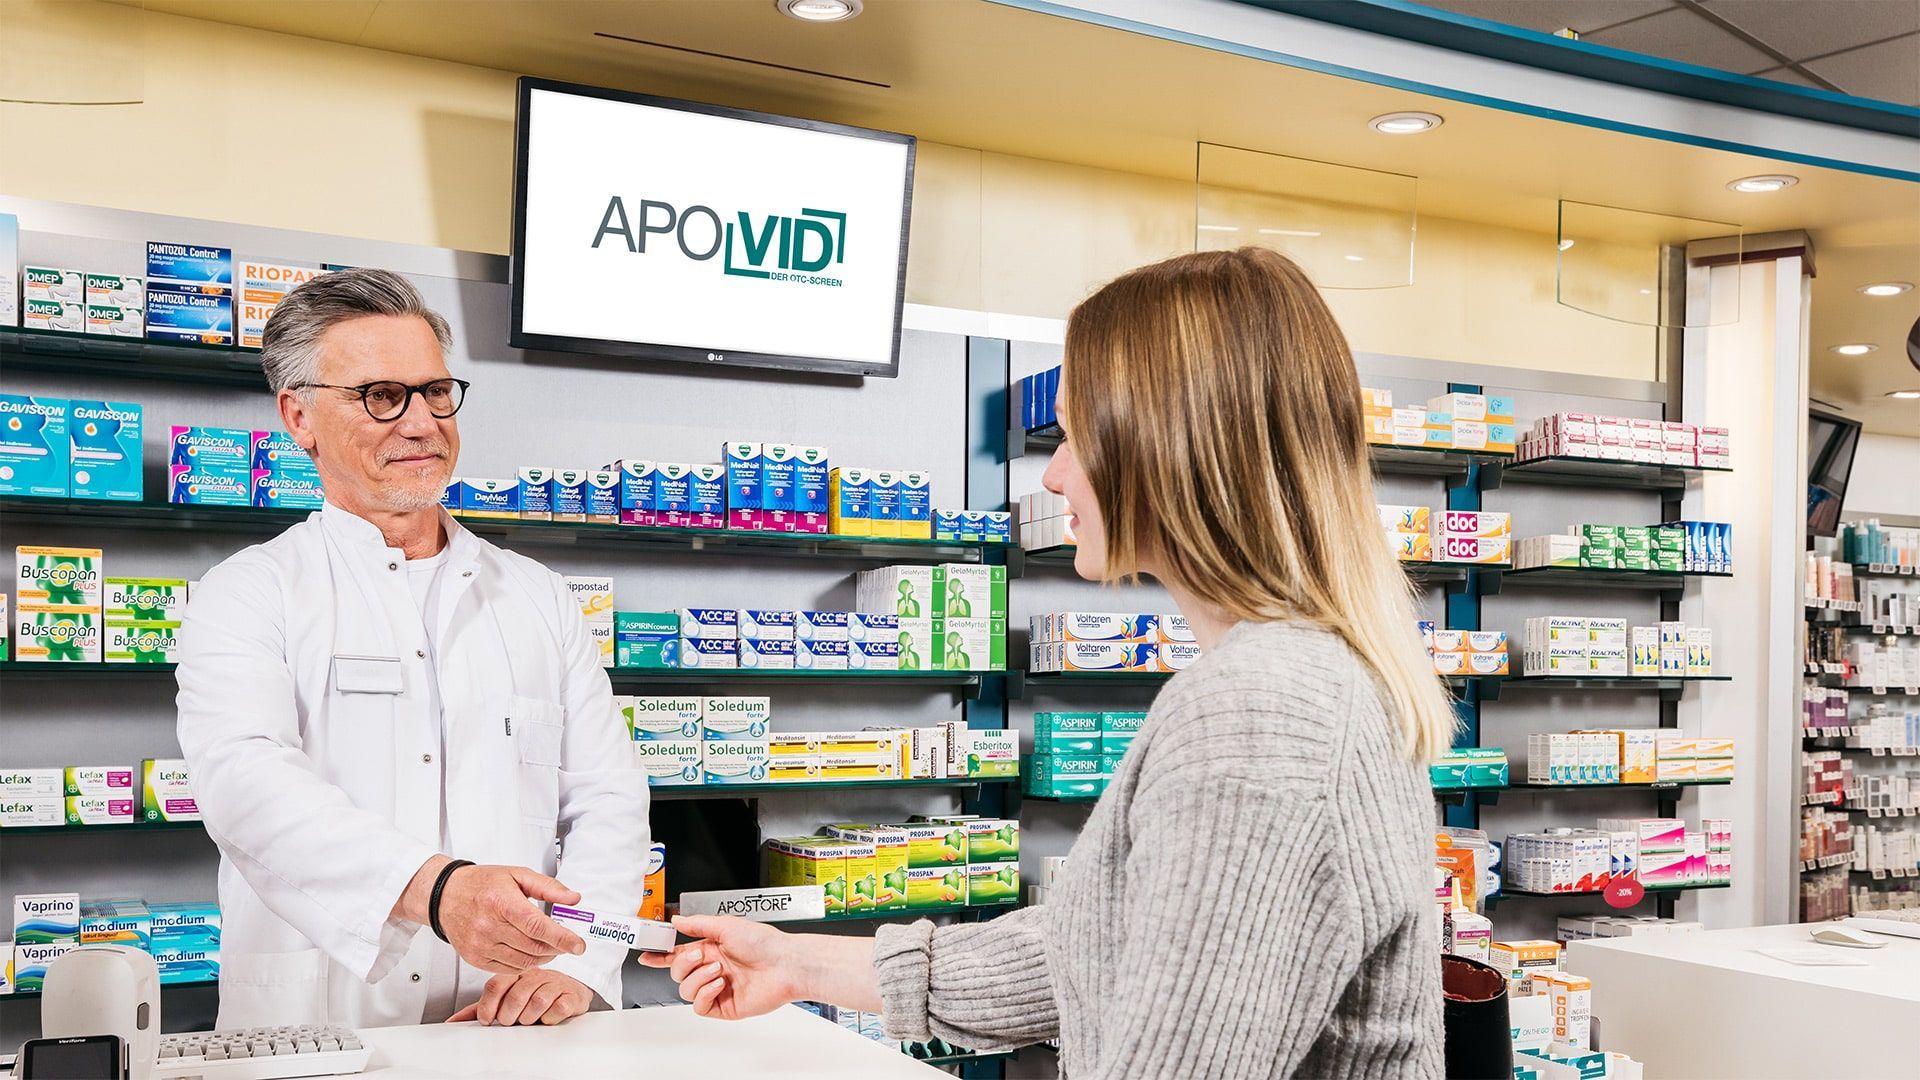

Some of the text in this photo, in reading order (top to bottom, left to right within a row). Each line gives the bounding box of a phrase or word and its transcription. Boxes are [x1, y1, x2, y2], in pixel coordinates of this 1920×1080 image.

[148, 243, 219, 259] PANTOZOL Control
[27, 272, 59, 285] OMEP
[88, 278, 119, 290] OMEP
[771, 273, 842, 288] DER OTC-SCREEN
[148, 292, 219, 308] PANTOZOL Control
[27, 303, 59, 316] OMEP
[88, 309, 120, 321] OMEP
[0, 402, 65, 418] GAVISCON
[74, 407, 139, 423] GAVISCON
[177, 435, 234, 447] GAVISCON
[178, 474, 235, 486] GAVISCON
[258, 478, 313, 489] GAVISCON
[475, 493, 507, 503] DayMed
[1448, 513, 1476, 531] doc
[1449, 538, 1477, 556] doc
[21, 565, 96, 583] Buscopan
[950, 567, 987, 576] GeloMyrtol
[74, 582, 97, 590] PLUS
[113, 592, 176, 606] Buscopan
[698, 610, 722, 622] ACC
[757, 611, 780, 622] ACC
[812, 612, 835, 623] ACC
[864, 615, 886, 625] ACC
[1075, 614, 1111, 623] Voltaren
[625, 622, 653, 630] ASPIRIN
[949, 620, 986, 629] GeloMyrtol
[21, 622, 96, 640] Buscopan
[73, 639, 96, 647] PLUS
[114, 634, 176, 649] Buscopan
[698, 639, 722, 650] ACC
[757, 640, 780, 651] ACC
[811, 641, 835, 652] ACC
[864, 642, 885, 653] ACC
[1075, 643, 1111, 653] Voltaren
[639, 700, 696, 712] Soledum
[709, 700, 764, 712] Soledum
[1060, 719, 1096, 728] ASPIRIN
[640, 744, 697, 756] Soledum
[709, 743, 764, 755] Soledum
[974, 741, 1012, 750] Esberitox
[1061, 761, 1097, 769] ASPIRIN
[0, 774, 31, 785] Lefax
[80, 771, 104, 779] Lefax
[160, 771, 188, 780] Lefax
[1, 803, 33, 813] Lefax
[81, 800, 105, 808] Lefax
[877, 836, 904, 844] PROSPAN
[1616, 888, 1633, 897] -20%
[22, 900, 73, 914] Vaprino
[717, 898, 788, 914] APOSTORE
[83, 922, 137, 932] Imodium
[152, 916, 205, 927] Imodium
[589, 925, 635, 945] Dolormin
[1523, 1028, 1532, 1036] ON
